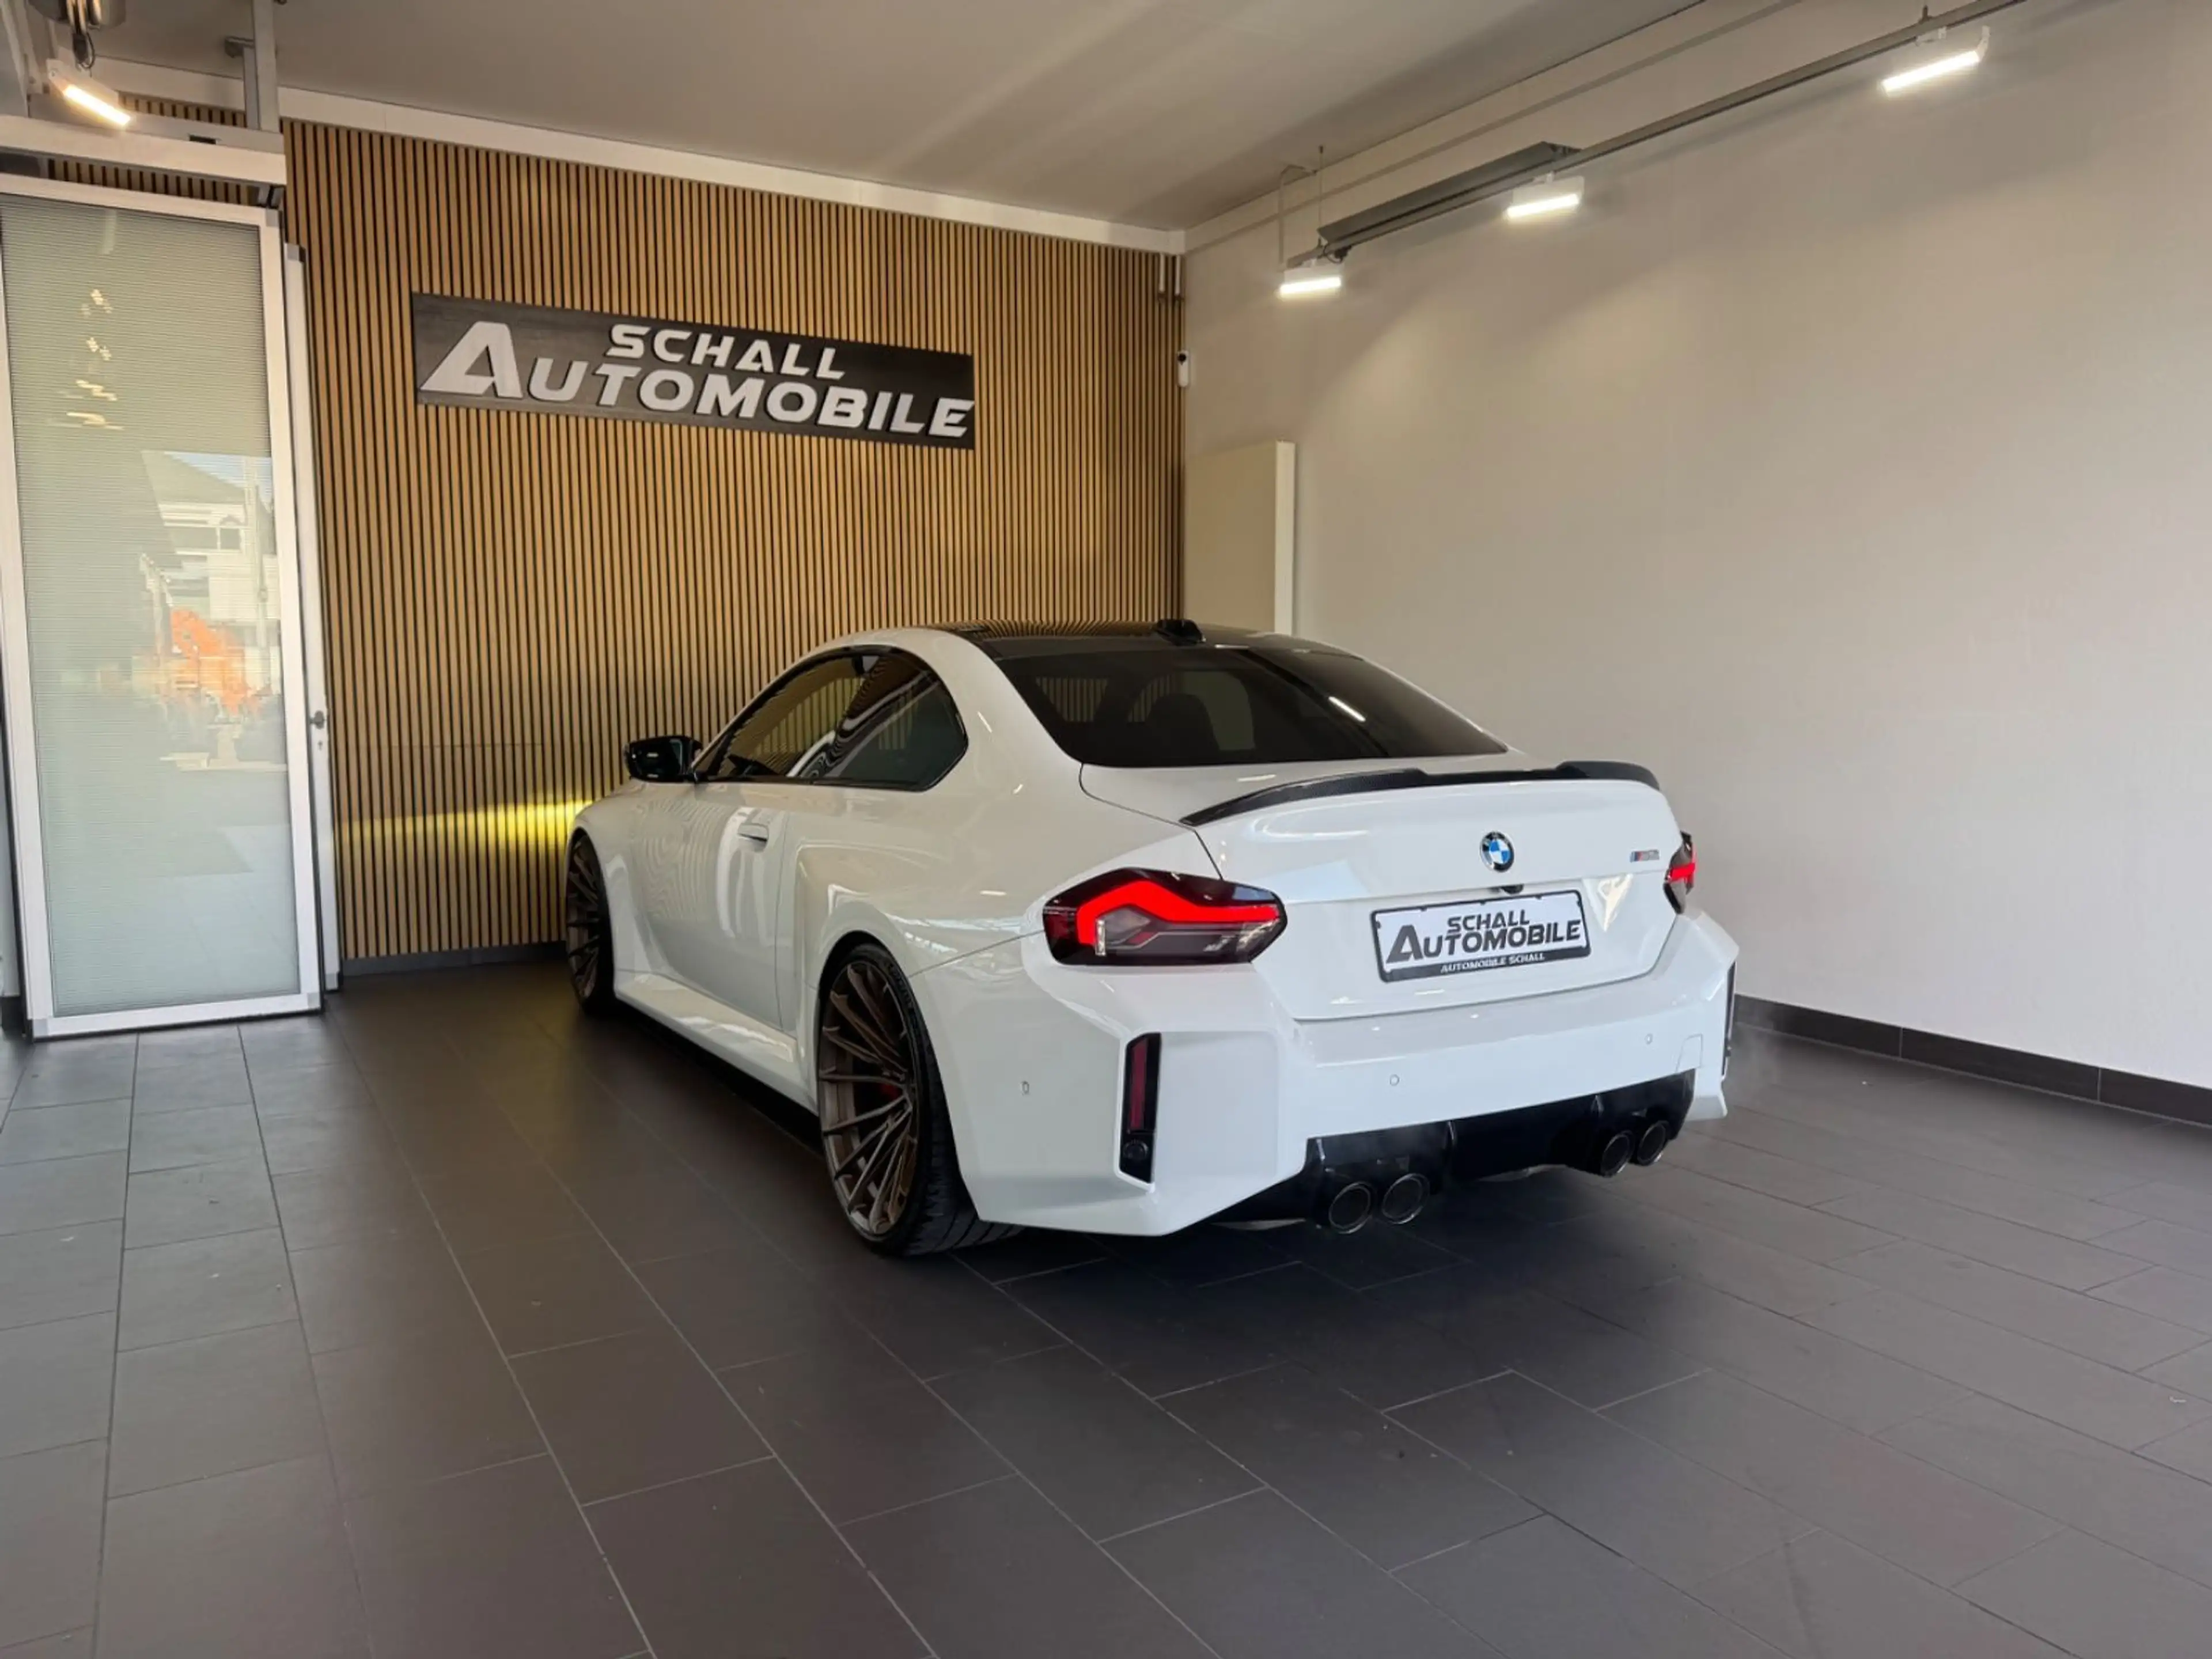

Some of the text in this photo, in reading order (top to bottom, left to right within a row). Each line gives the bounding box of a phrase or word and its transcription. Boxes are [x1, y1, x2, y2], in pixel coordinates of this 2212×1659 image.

[607, 323, 849, 381] SCHALL
[419, 320, 975, 438] AUTOMOBILE
[1385, 919, 1581, 964] AUTOMOBILE
[1447, 909, 1530, 934] SCHALL
[1441, 952, 1545, 974] AUTOMOBILE SCHALL
